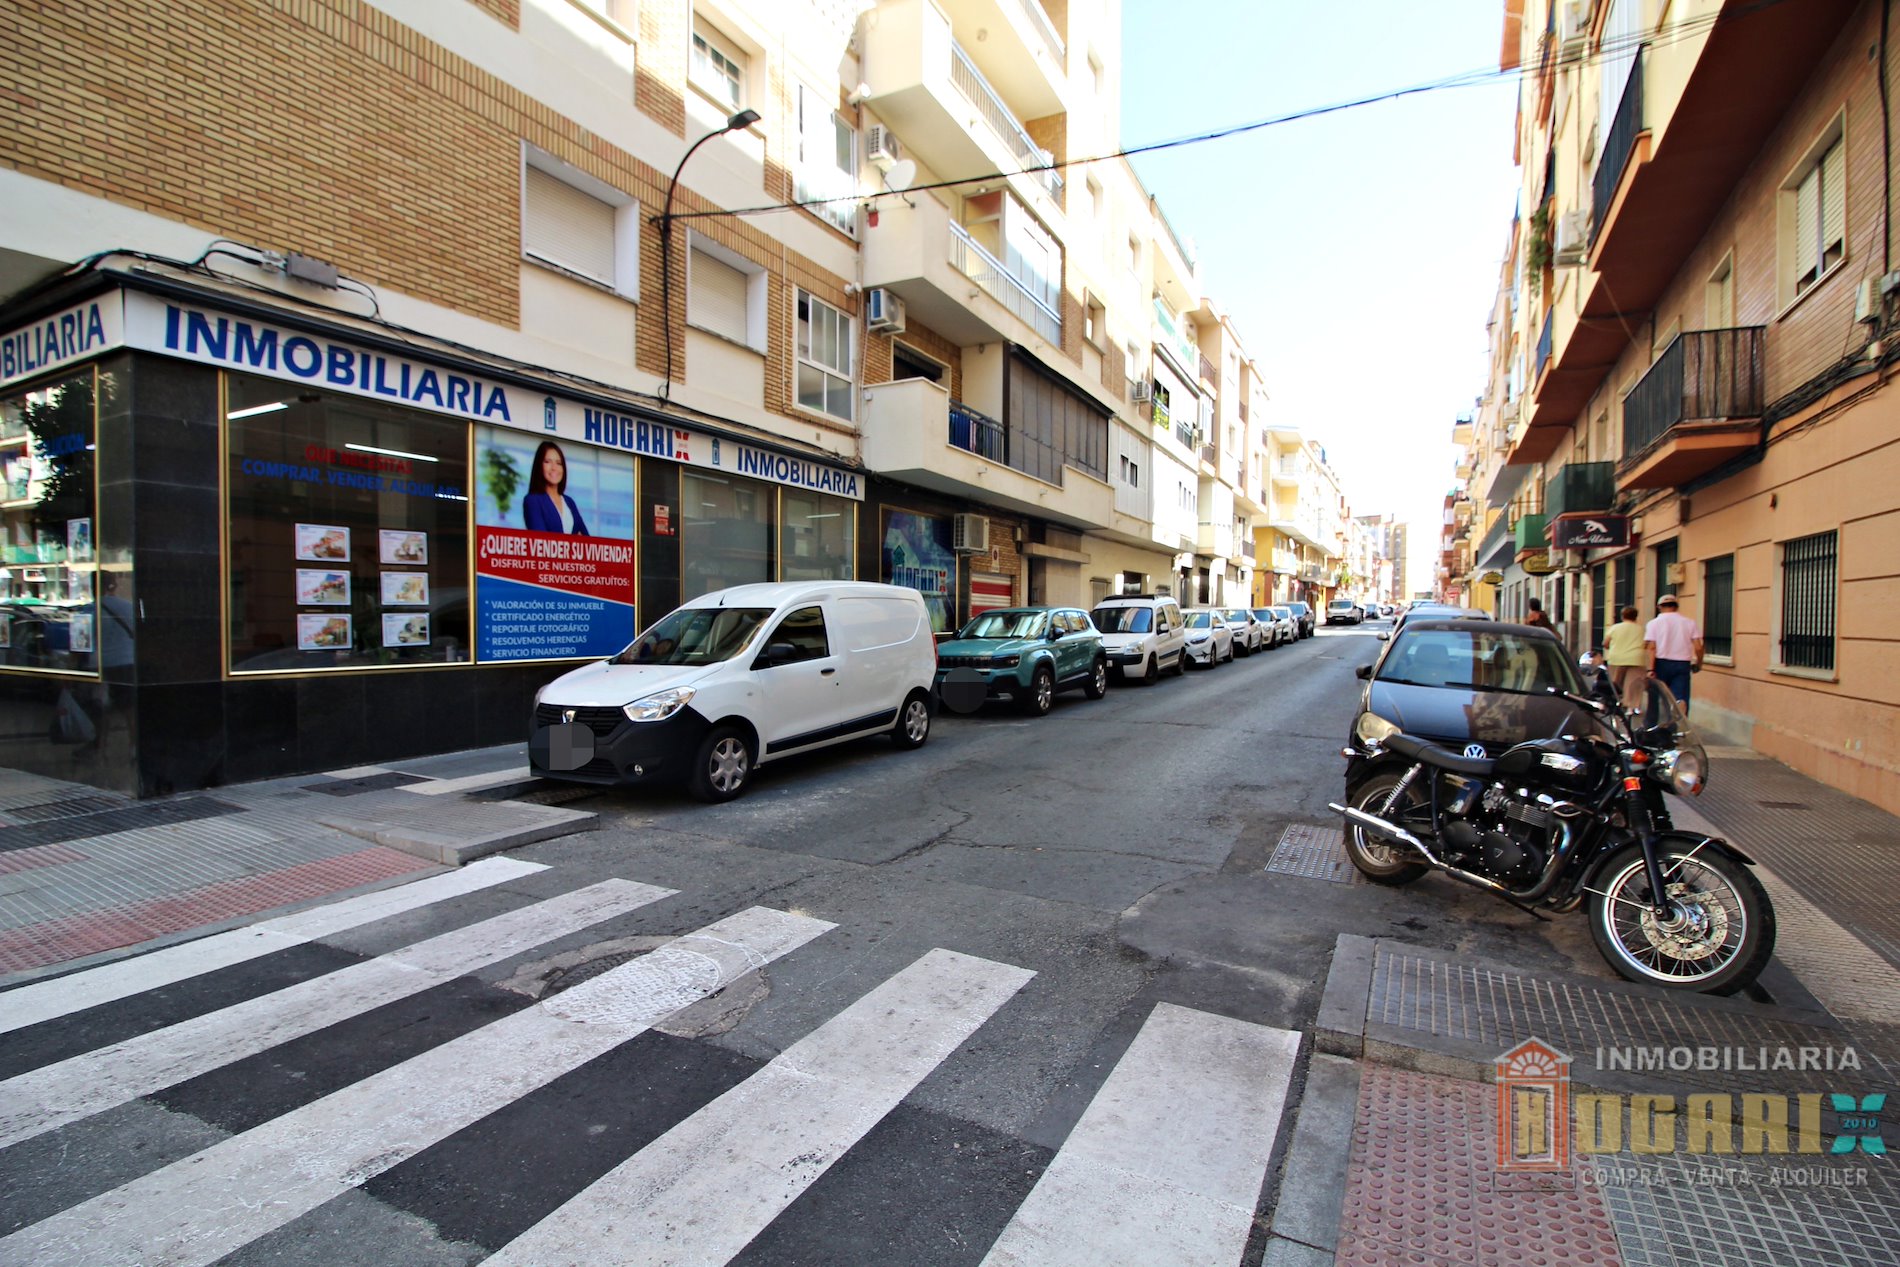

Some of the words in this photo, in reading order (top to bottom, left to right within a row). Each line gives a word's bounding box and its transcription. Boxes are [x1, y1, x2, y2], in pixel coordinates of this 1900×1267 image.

[0, 303, 105, 379] BILIARIA
[164, 304, 511, 422] INMOBILIARIA
[737, 447, 857, 496] INMOBILIARIA
[481, 534, 527, 558] ¿QUIERE
[529, 538, 570, 559] VENDER
[571, 541, 584, 560] SU
[585, 543, 632, 563] VIVIENDA?
[491, 557, 537, 569] DISFRUTE
[538, 560, 551, 571] DE
[552, 561, 596, 573] NUESTROS
[538, 573, 583, 585] SERVICIOS
[491, 600, 544, 610] VALORACIÓN
[545, 601, 556, 610] DE
[557, 602, 567, 610] SU
[568, 602, 605, 610] INMUEBLE
[491, 612, 544, 622] CERTIFICADO
[545, 611, 591, 621] ENERGÉTICO
[491, 624, 537, 634] REPORTAJE
[538, 623, 590, 633] FOTOGRÁFICO
[492, 636, 545, 646] RESOLVEMOS
[546, 635, 587, 644] HERENCIAS
[492, 648, 530, 658] SERVICIO
[531, 647, 576, 657] FINANCIERO
